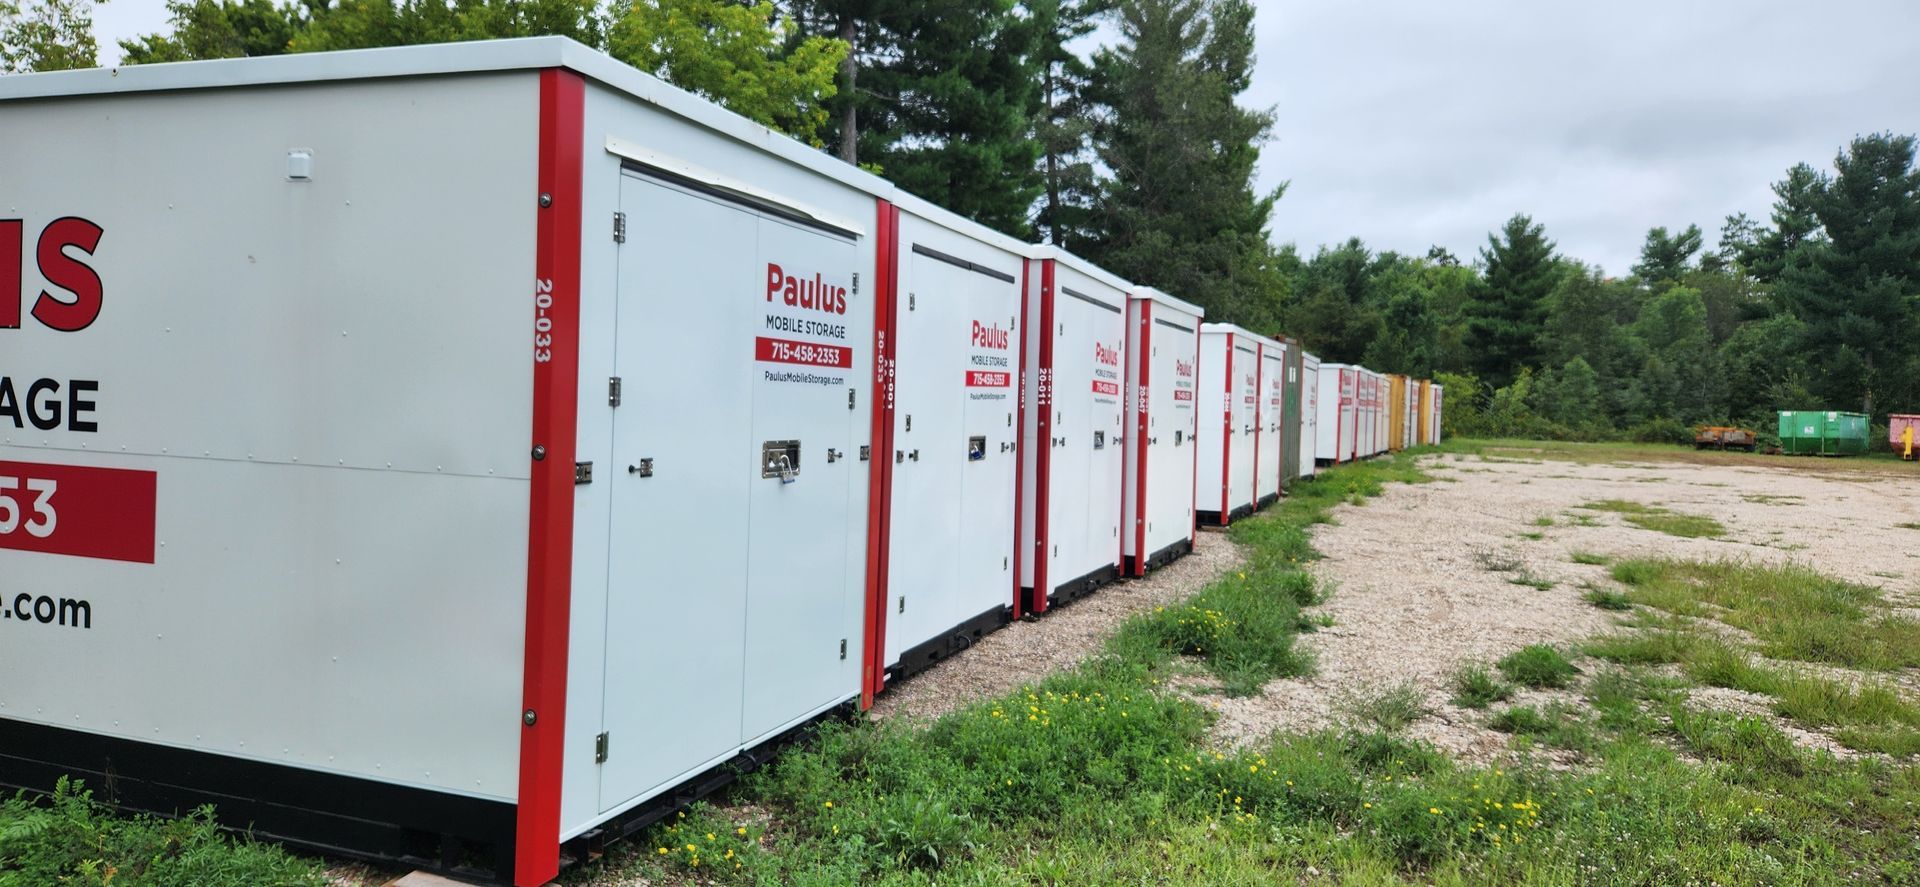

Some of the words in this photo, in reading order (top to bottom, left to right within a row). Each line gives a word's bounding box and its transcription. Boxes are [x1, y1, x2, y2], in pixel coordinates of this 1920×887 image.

[766, 262, 846, 315] Paulus
[535, 279, 553, 362] 20-033
[766, 315, 803, 333] MOBILE
[806, 321, 845, 339] STORAGE
[972, 320, 1008, 350] Paulus
[772, 341, 840, 365] 715-458-2353
[765, 371, 844, 386] PaulusMobileStorage.com
[1038, 368, 1047, 405] 20-011
[0, 592, 91, 628] .com
